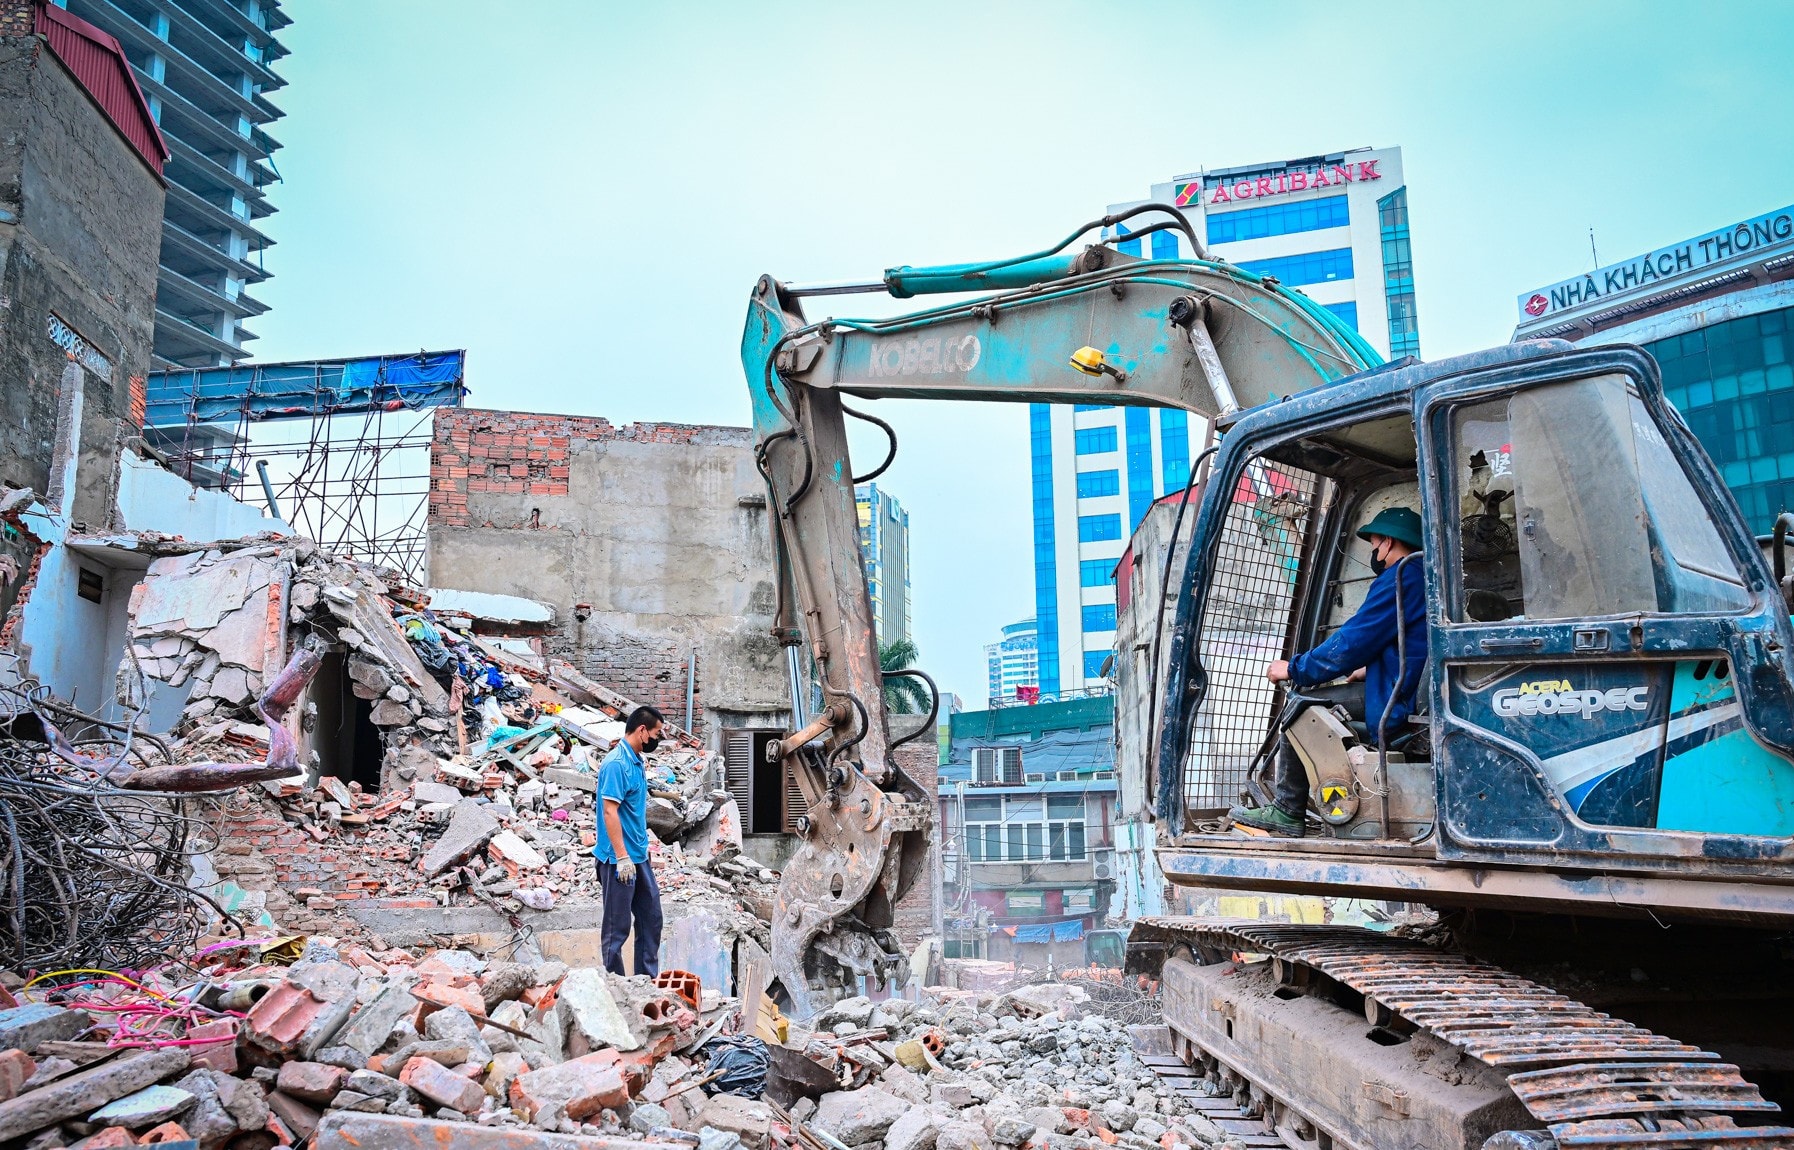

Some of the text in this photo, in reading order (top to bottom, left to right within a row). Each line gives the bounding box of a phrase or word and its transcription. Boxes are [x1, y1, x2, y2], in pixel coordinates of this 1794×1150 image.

[1211, 160, 1381, 203] AGRIBANK
[1551, 214, 1792, 311] NHÀ KHÁCH THÔNG
[869, 335, 981, 378] KOBELCO
[1519, 679, 1574, 696] ACERA
